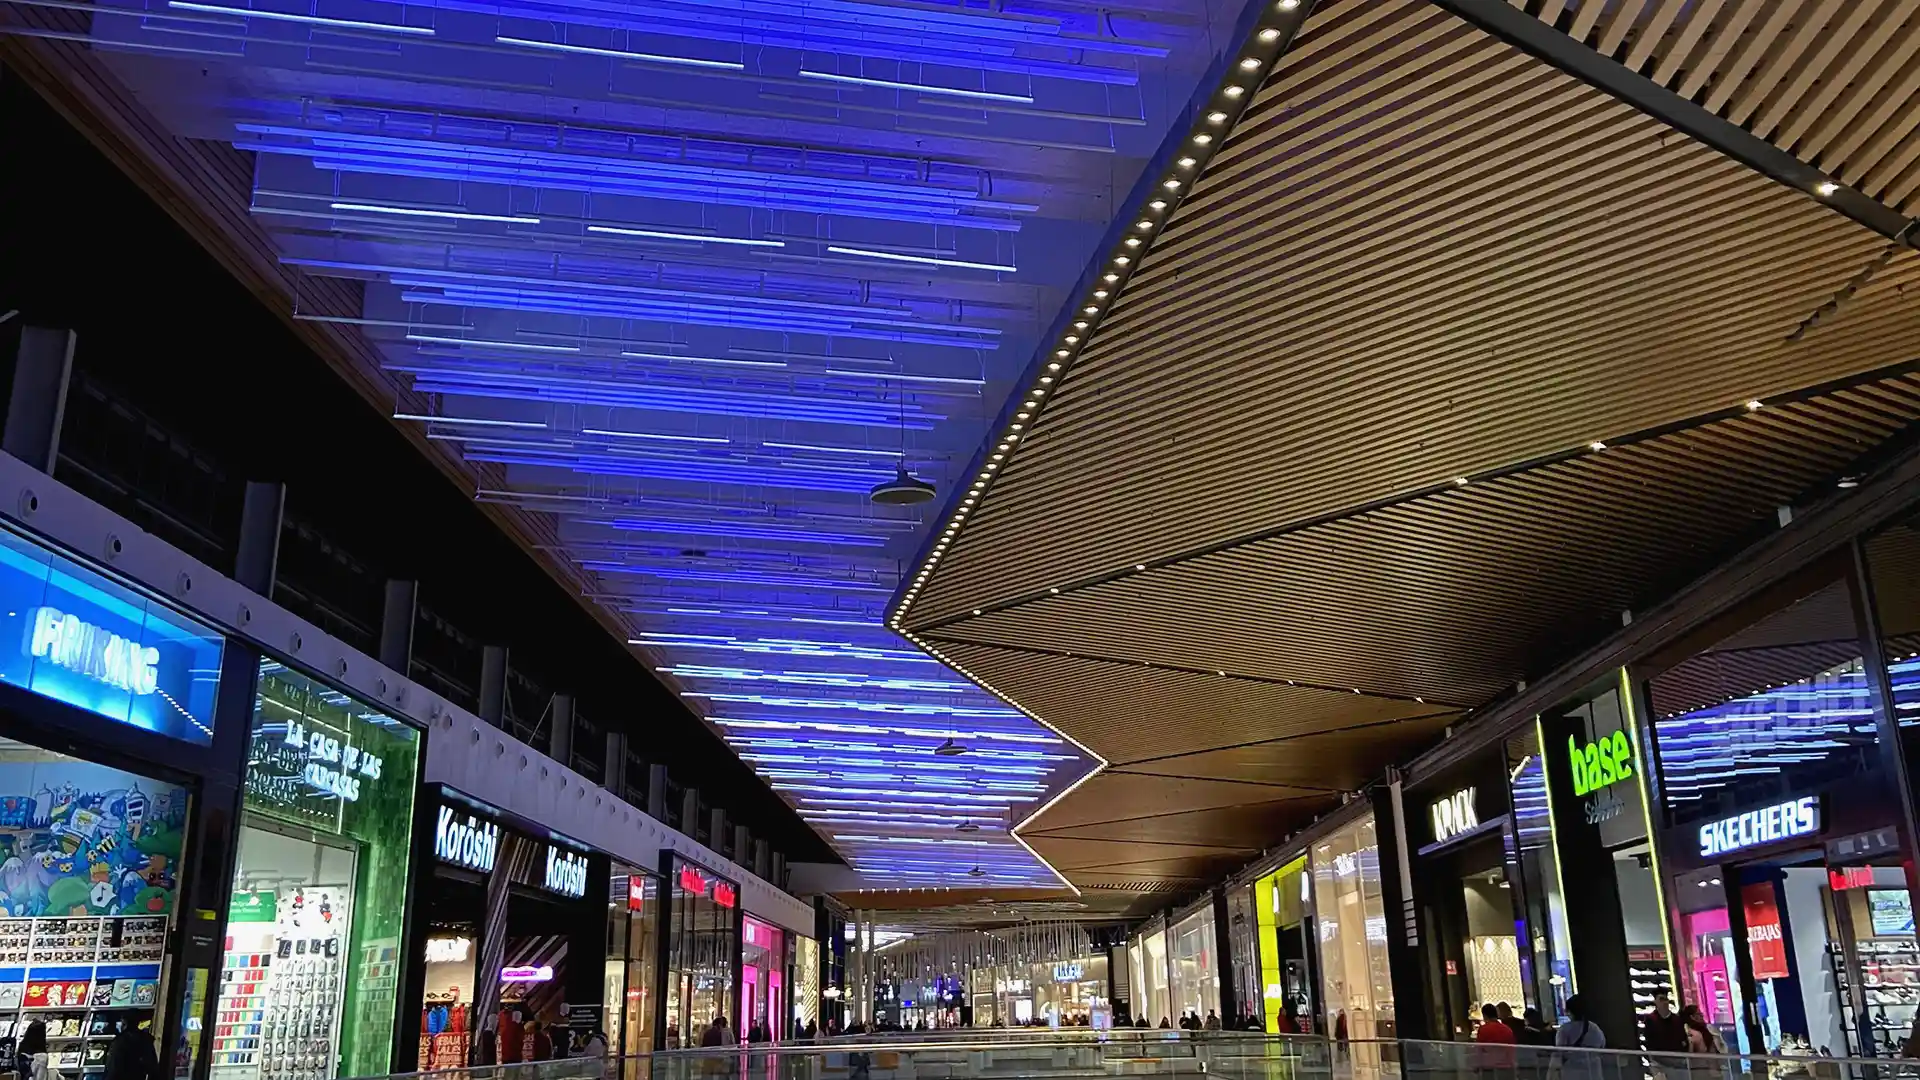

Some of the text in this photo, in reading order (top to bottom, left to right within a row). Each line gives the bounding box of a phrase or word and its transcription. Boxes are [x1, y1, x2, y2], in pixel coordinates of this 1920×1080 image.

[285, 719, 304, 748] LA
[310, 731, 339, 772] CASA
[342, 744, 359, 770] DE
[360, 751, 382, 780] LAS
[1568, 730, 1632, 796] base
[305, 763, 360, 801] CARCASAS
[1700, 796, 1815, 857] SKECHERS
